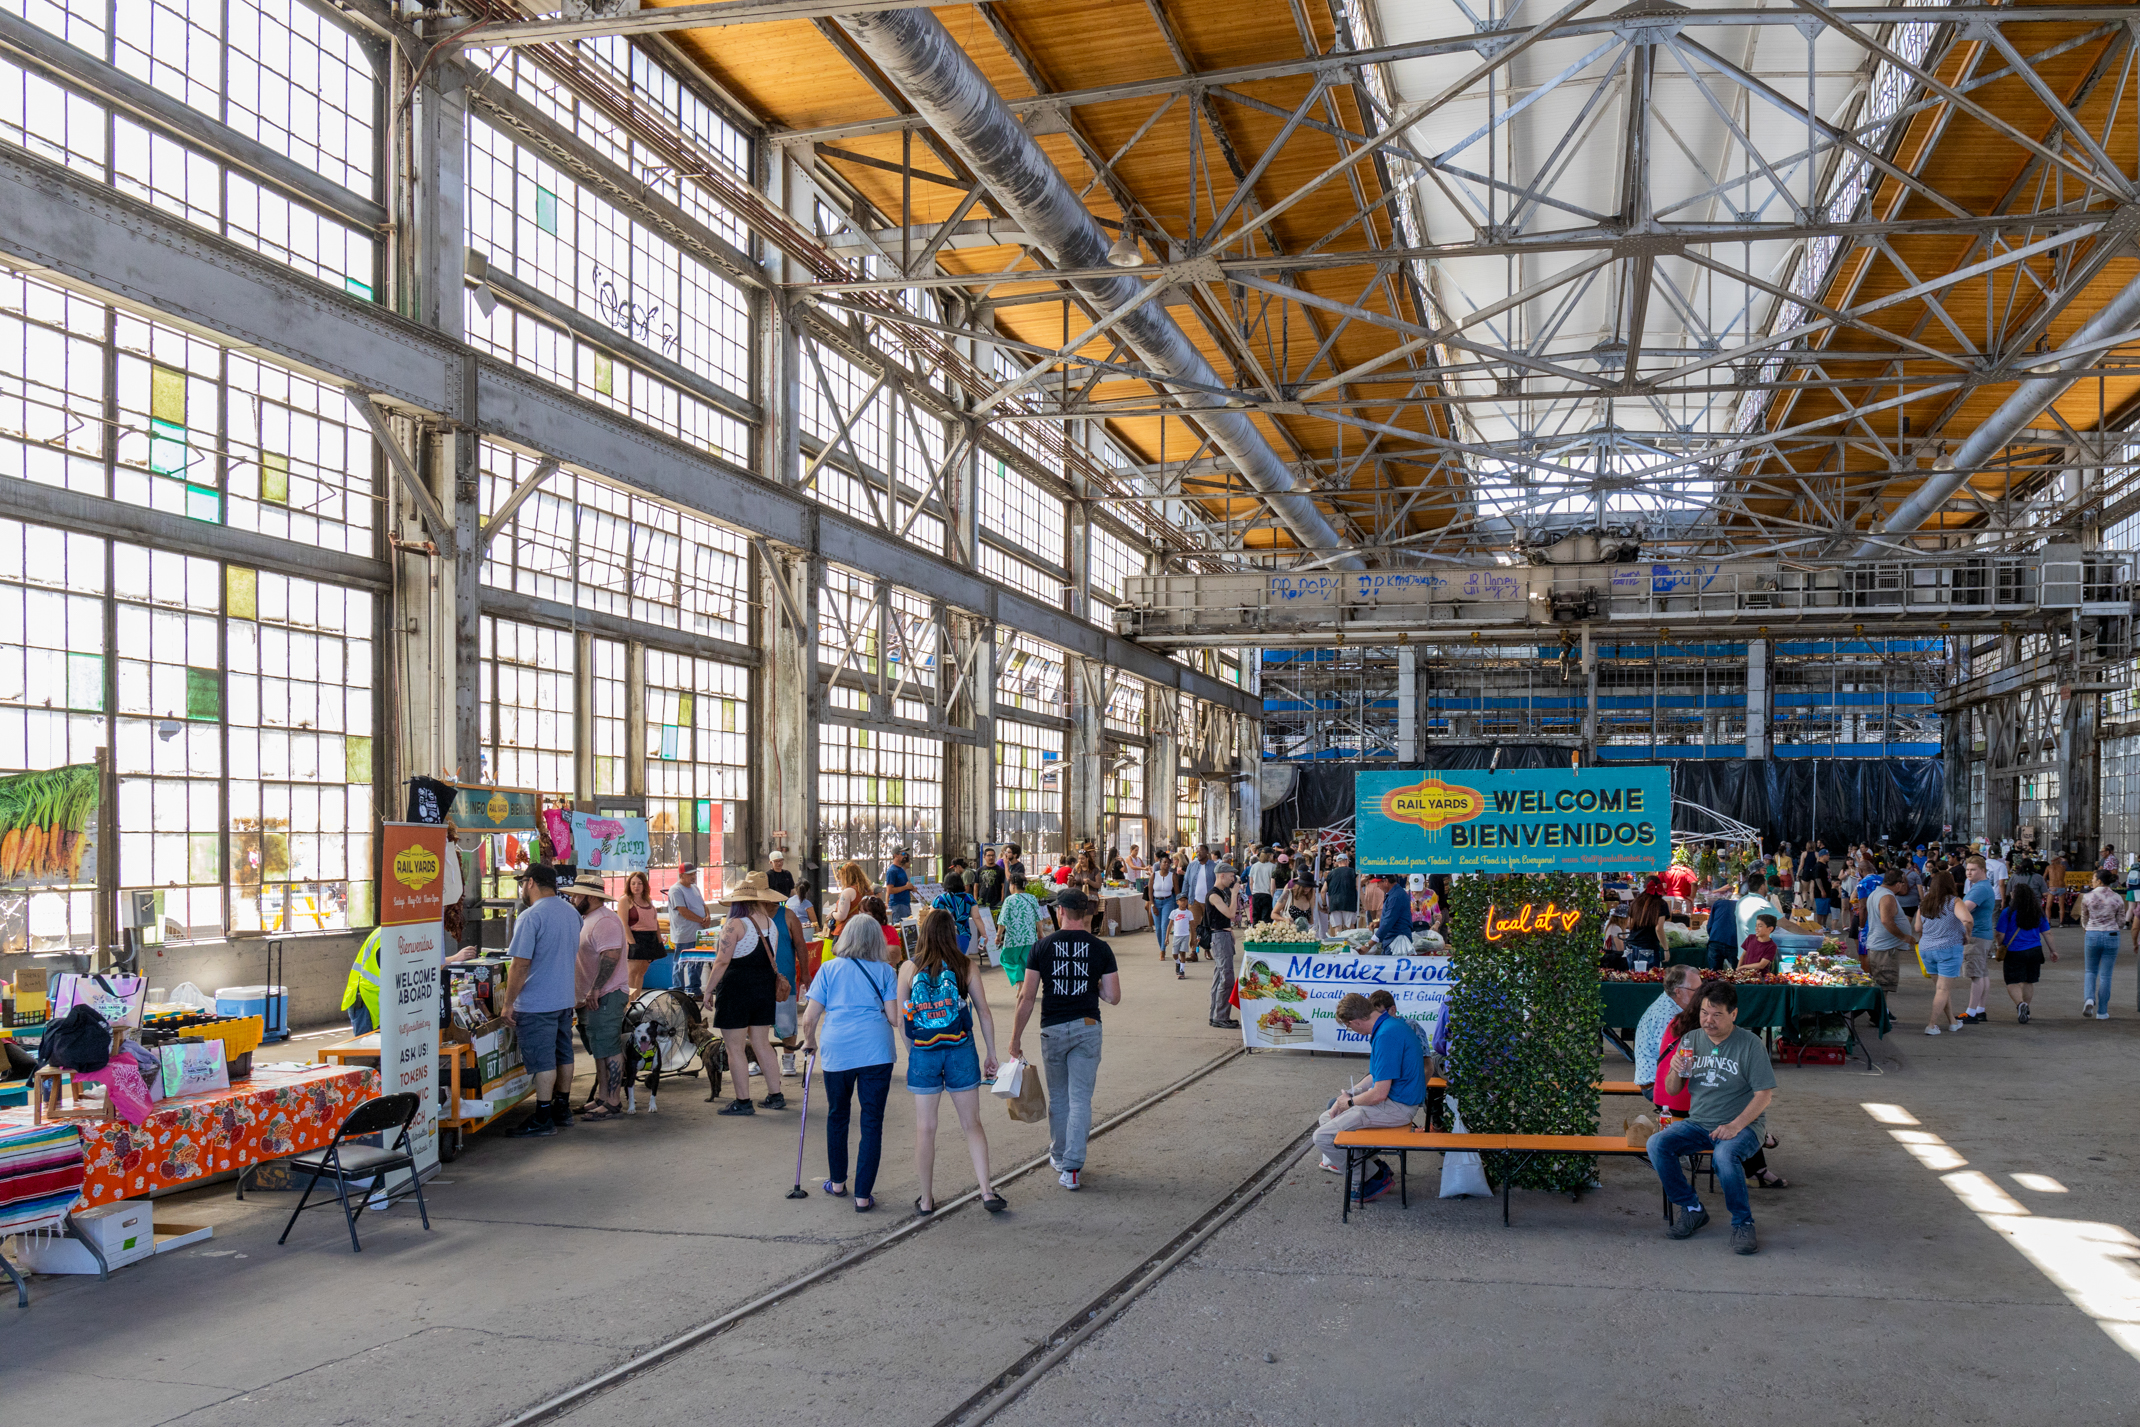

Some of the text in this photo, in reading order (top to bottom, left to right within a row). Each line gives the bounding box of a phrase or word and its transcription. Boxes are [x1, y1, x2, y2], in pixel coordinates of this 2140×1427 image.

[470, 801, 487, 815] INFO
[489, 803, 508, 813] RAIL YARDS
[1397, 799, 1468, 810] RAIL YARDS
[1493, 788, 1644, 814] WELCOME
[1422, 811, 1442, 819] market
[1451, 822, 1656, 848] BIENVENIDOS
[613, 835, 646, 857] Farm
[397, 860, 436, 874] RAIL YARDS
[1389, 856, 1409, 866] Local
[1410, 858, 1427, 869] para
[1428, 856, 1452, 866] Todos!
[1459, 854, 1556, 868] Local Food is for Everyone!
[1485, 904, 1561, 941] Local at
[398, 935, 434, 956] Bienvenidos
[395, 967, 437, 989] WELCOME
[1286, 955, 1387, 984] Mendez
[398, 984, 433, 1006] ABOARD
[1403, 991, 1414, 1001] El
[933, 1000, 944, 1010] TO
[927, 1009, 948, 1019] KIND
[400, 1042, 429, 1064] ASK US!
[400, 1064, 428, 1087] TOKENS
